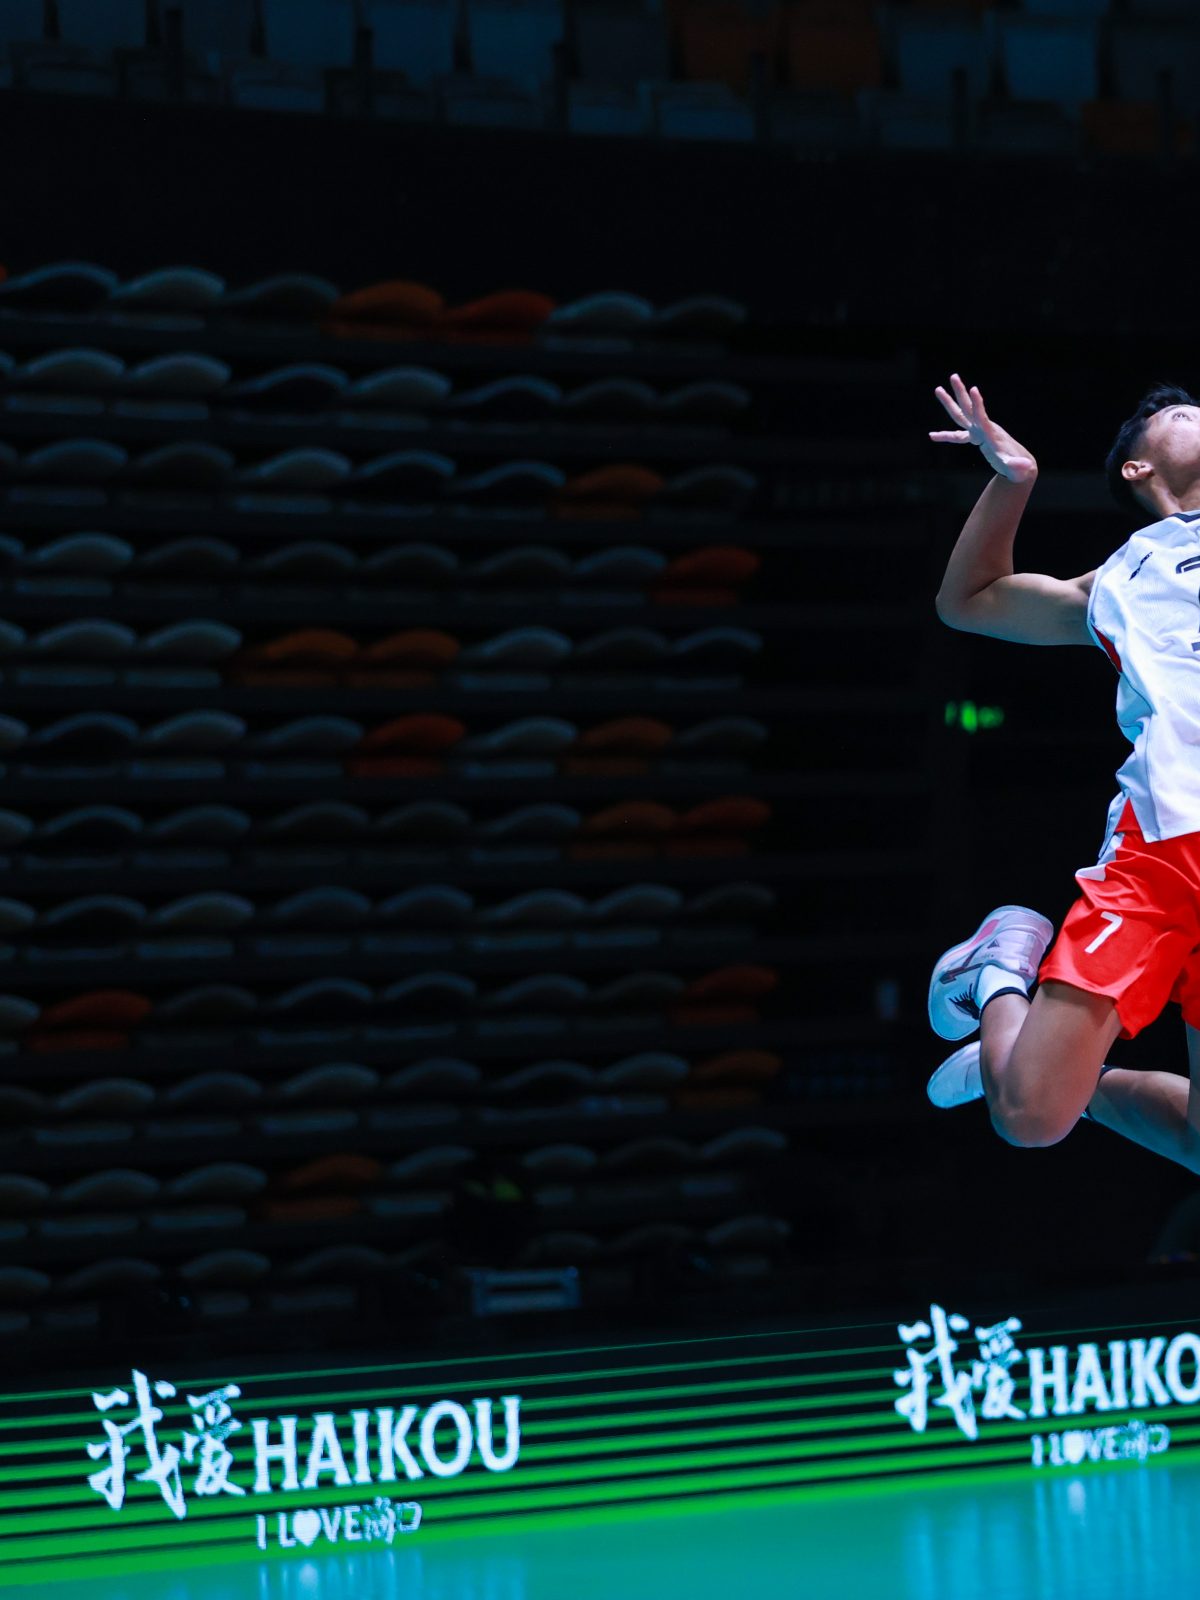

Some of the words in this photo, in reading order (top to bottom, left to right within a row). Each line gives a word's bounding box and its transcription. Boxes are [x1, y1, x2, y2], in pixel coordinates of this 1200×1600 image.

[1084, 911, 1123, 954] 7
[250, 1396, 521, 1494] HAIKOU
[1031, 1434, 1043, 1467] I
[256, 1514, 267, 1550] I
